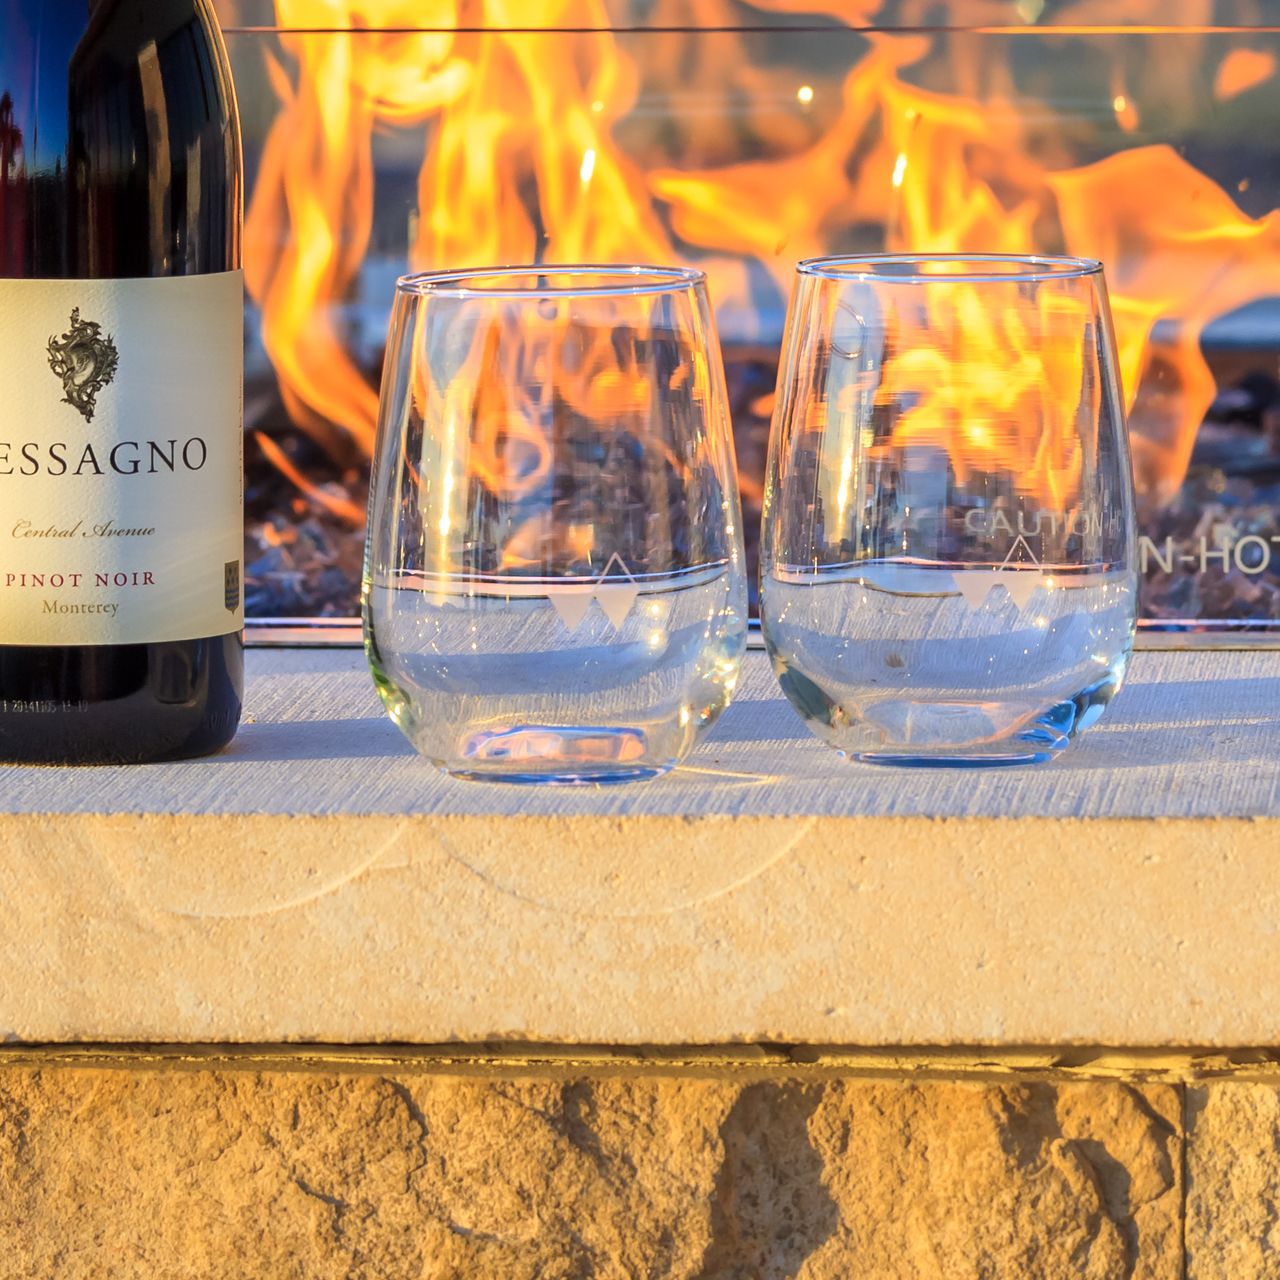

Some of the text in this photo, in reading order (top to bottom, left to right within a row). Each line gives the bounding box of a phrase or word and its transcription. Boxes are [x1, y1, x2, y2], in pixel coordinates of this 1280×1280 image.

[11, 519, 156, 539] Central Avenue
[5, 571, 156, 588] PINOT NOIR
[41, 599, 120, 618] Monterey
